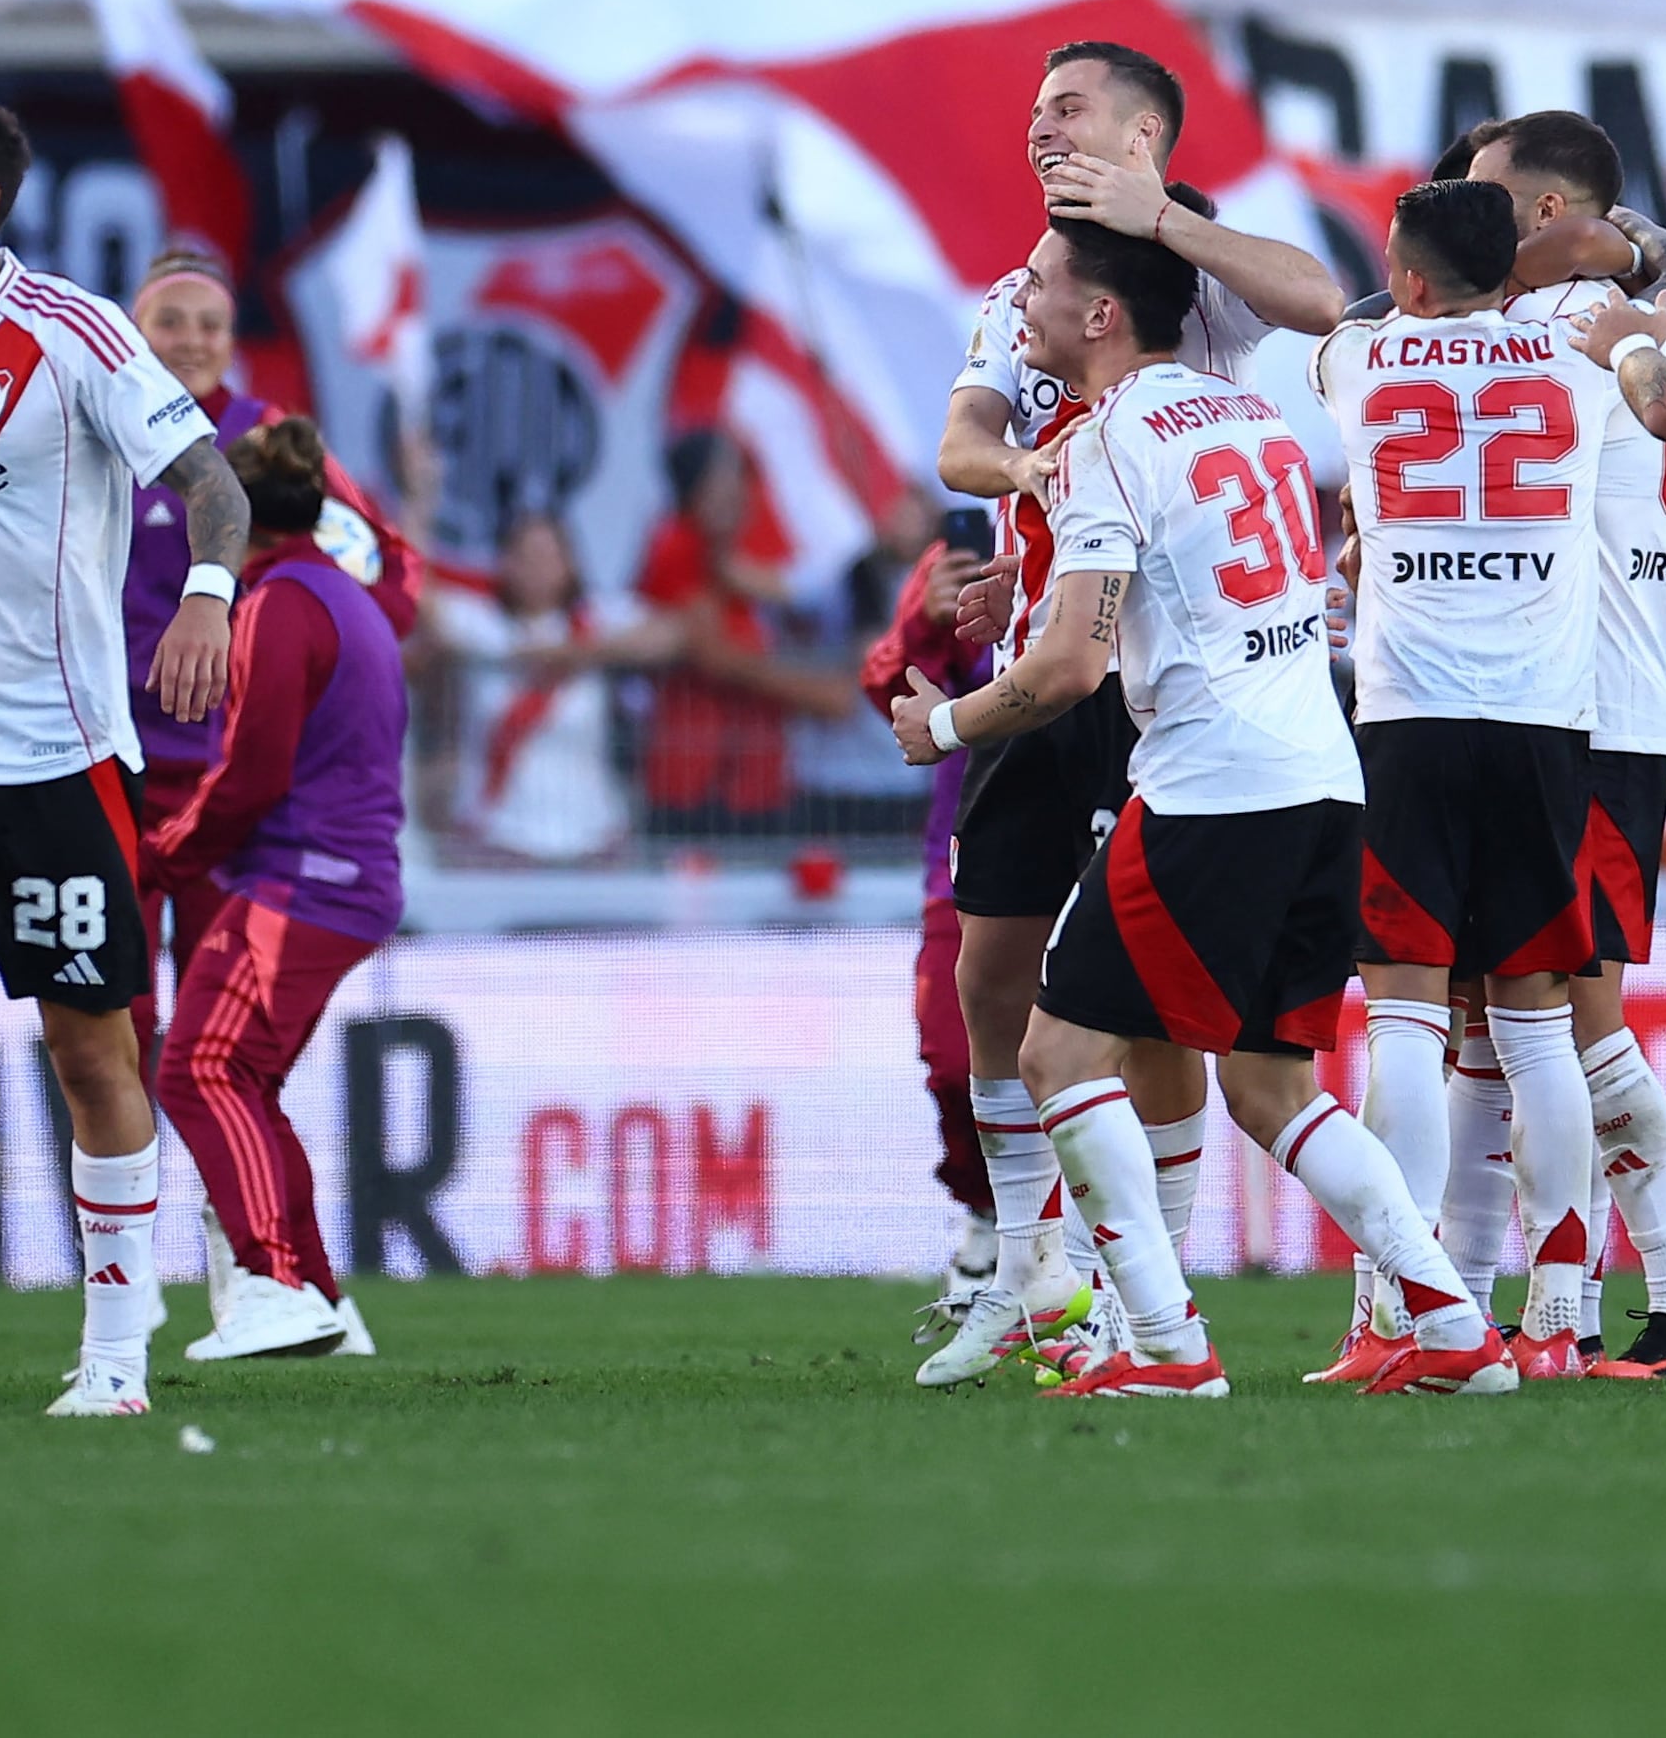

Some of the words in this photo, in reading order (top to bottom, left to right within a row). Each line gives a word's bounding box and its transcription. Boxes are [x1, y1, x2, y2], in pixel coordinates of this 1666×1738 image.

[1361, 374, 1580, 525] 22
[1187, 435, 1328, 609] 30
[1102, 575, 1121, 598] 18
[1391, 551, 1556, 584] DIRECTV
[1097, 597, 1117, 621] 12
[1244, 613, 1321, 662] DIREC
[11, 874, 107, 951] 28
